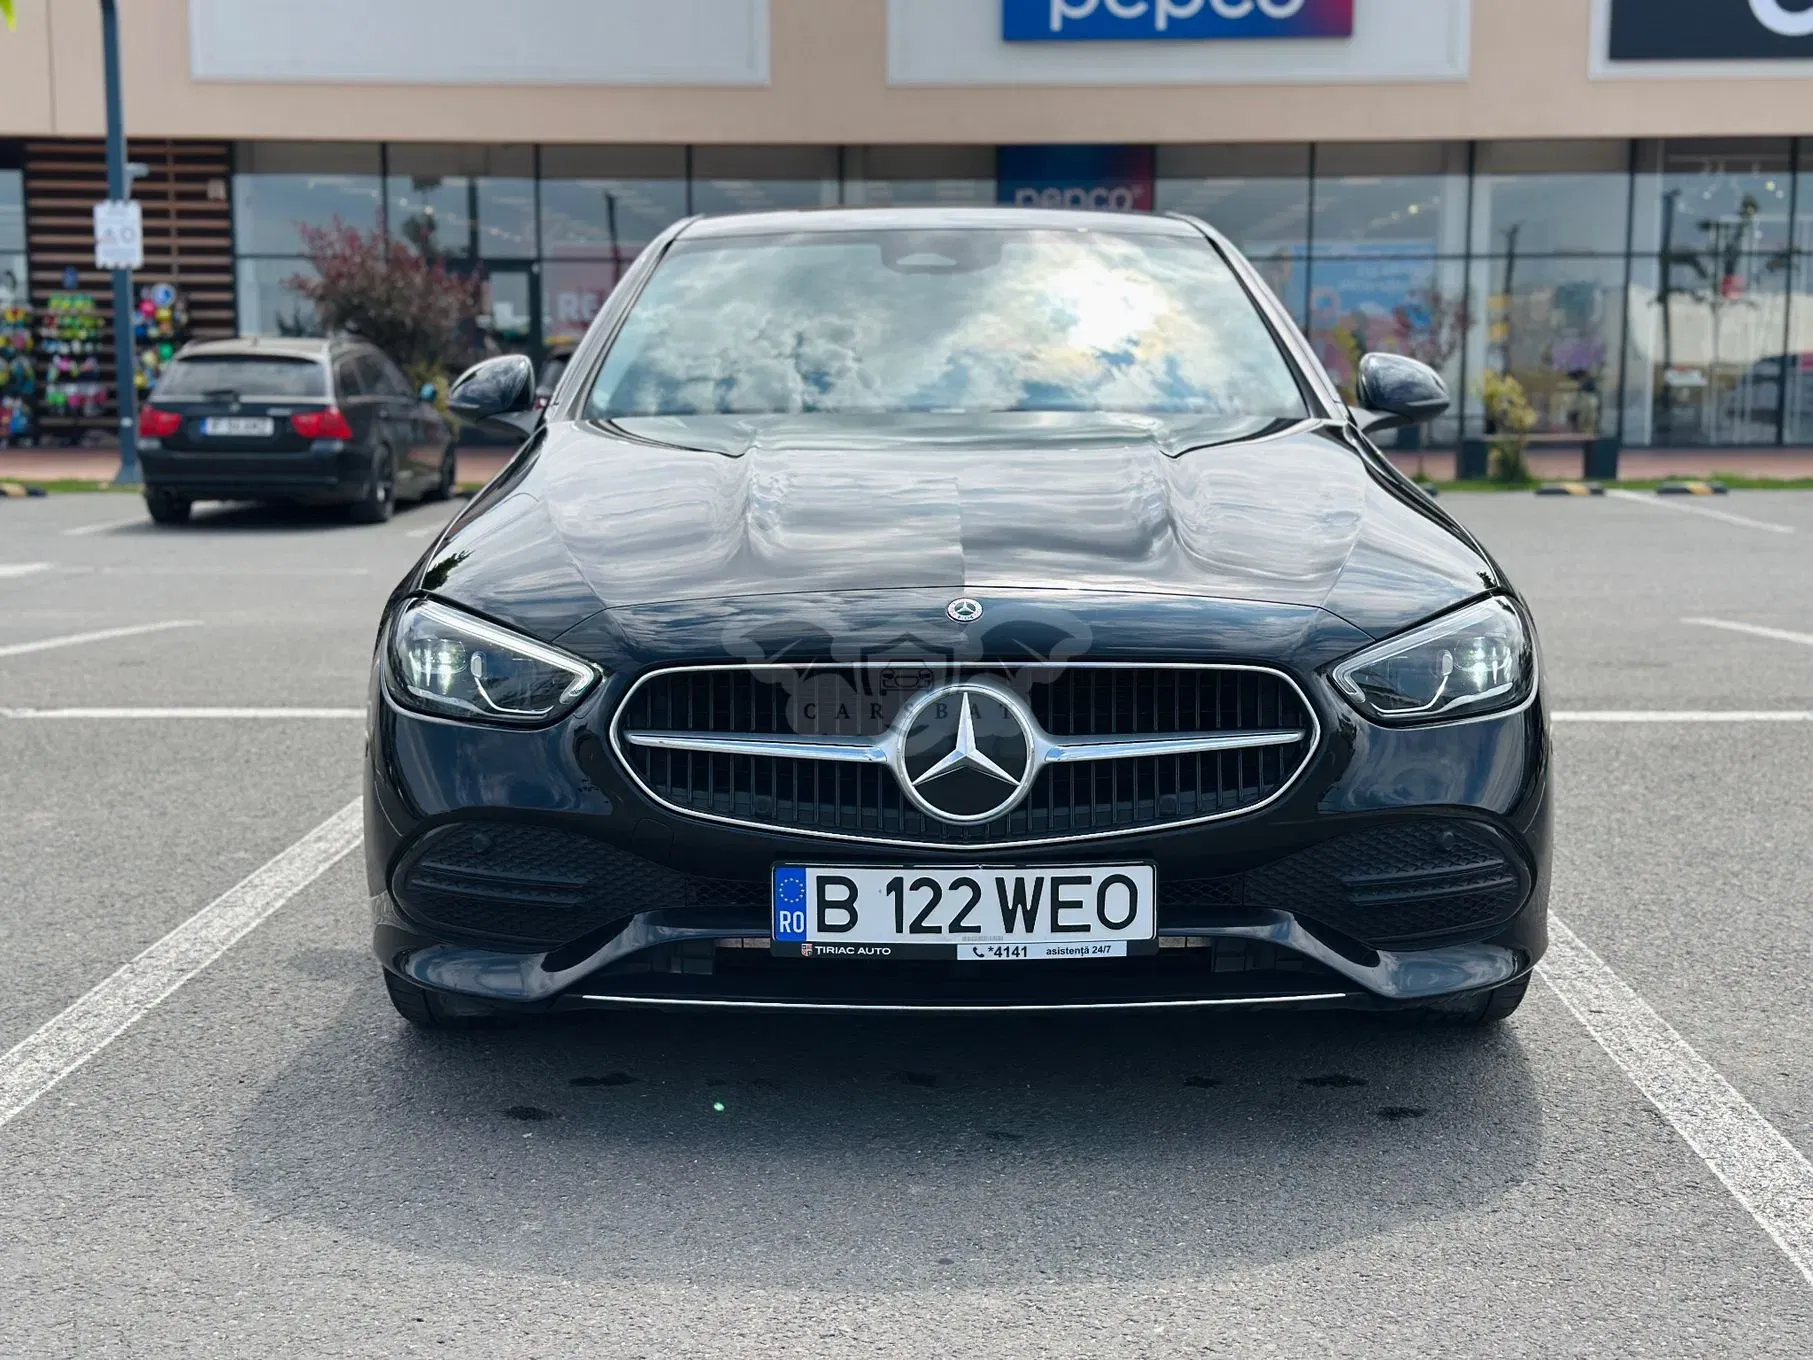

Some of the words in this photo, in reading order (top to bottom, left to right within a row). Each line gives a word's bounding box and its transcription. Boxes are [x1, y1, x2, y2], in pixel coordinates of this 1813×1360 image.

[816, 875, 858, 933] B
[886, 876, 982, 934] 122
[995, 874, 1138, 933] WEO
[779, 910, 804, 933] RO
[815, 946, 855, 955] TIRIAC
[857, 947, 892, 955] AUTO
[1092, 945, 1111, 954] 24/7
